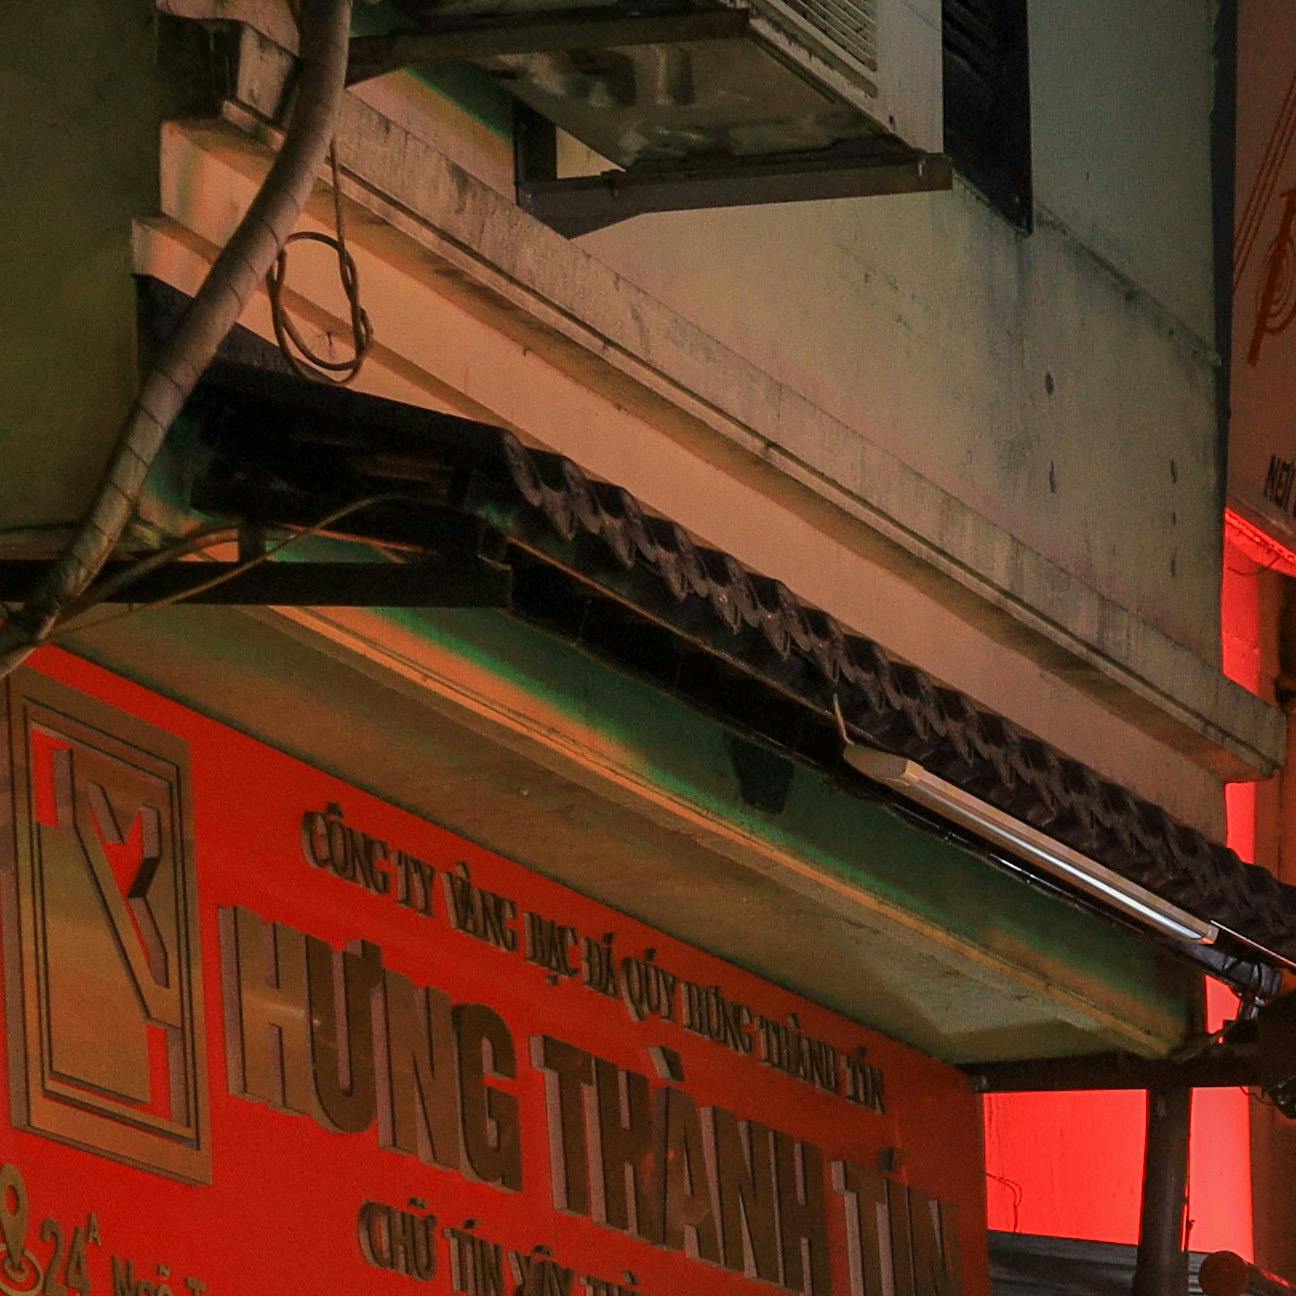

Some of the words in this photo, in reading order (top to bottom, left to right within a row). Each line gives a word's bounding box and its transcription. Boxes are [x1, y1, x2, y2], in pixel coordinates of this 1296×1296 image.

[219, 904, 525, 1193] HƯNG
[302, 802, 390, 895] CÔNG
[390, 849, 436, 918] TY
[441, 860, 518, 953] VÀNG
[840, 1046, 886, 1116] TÍN
